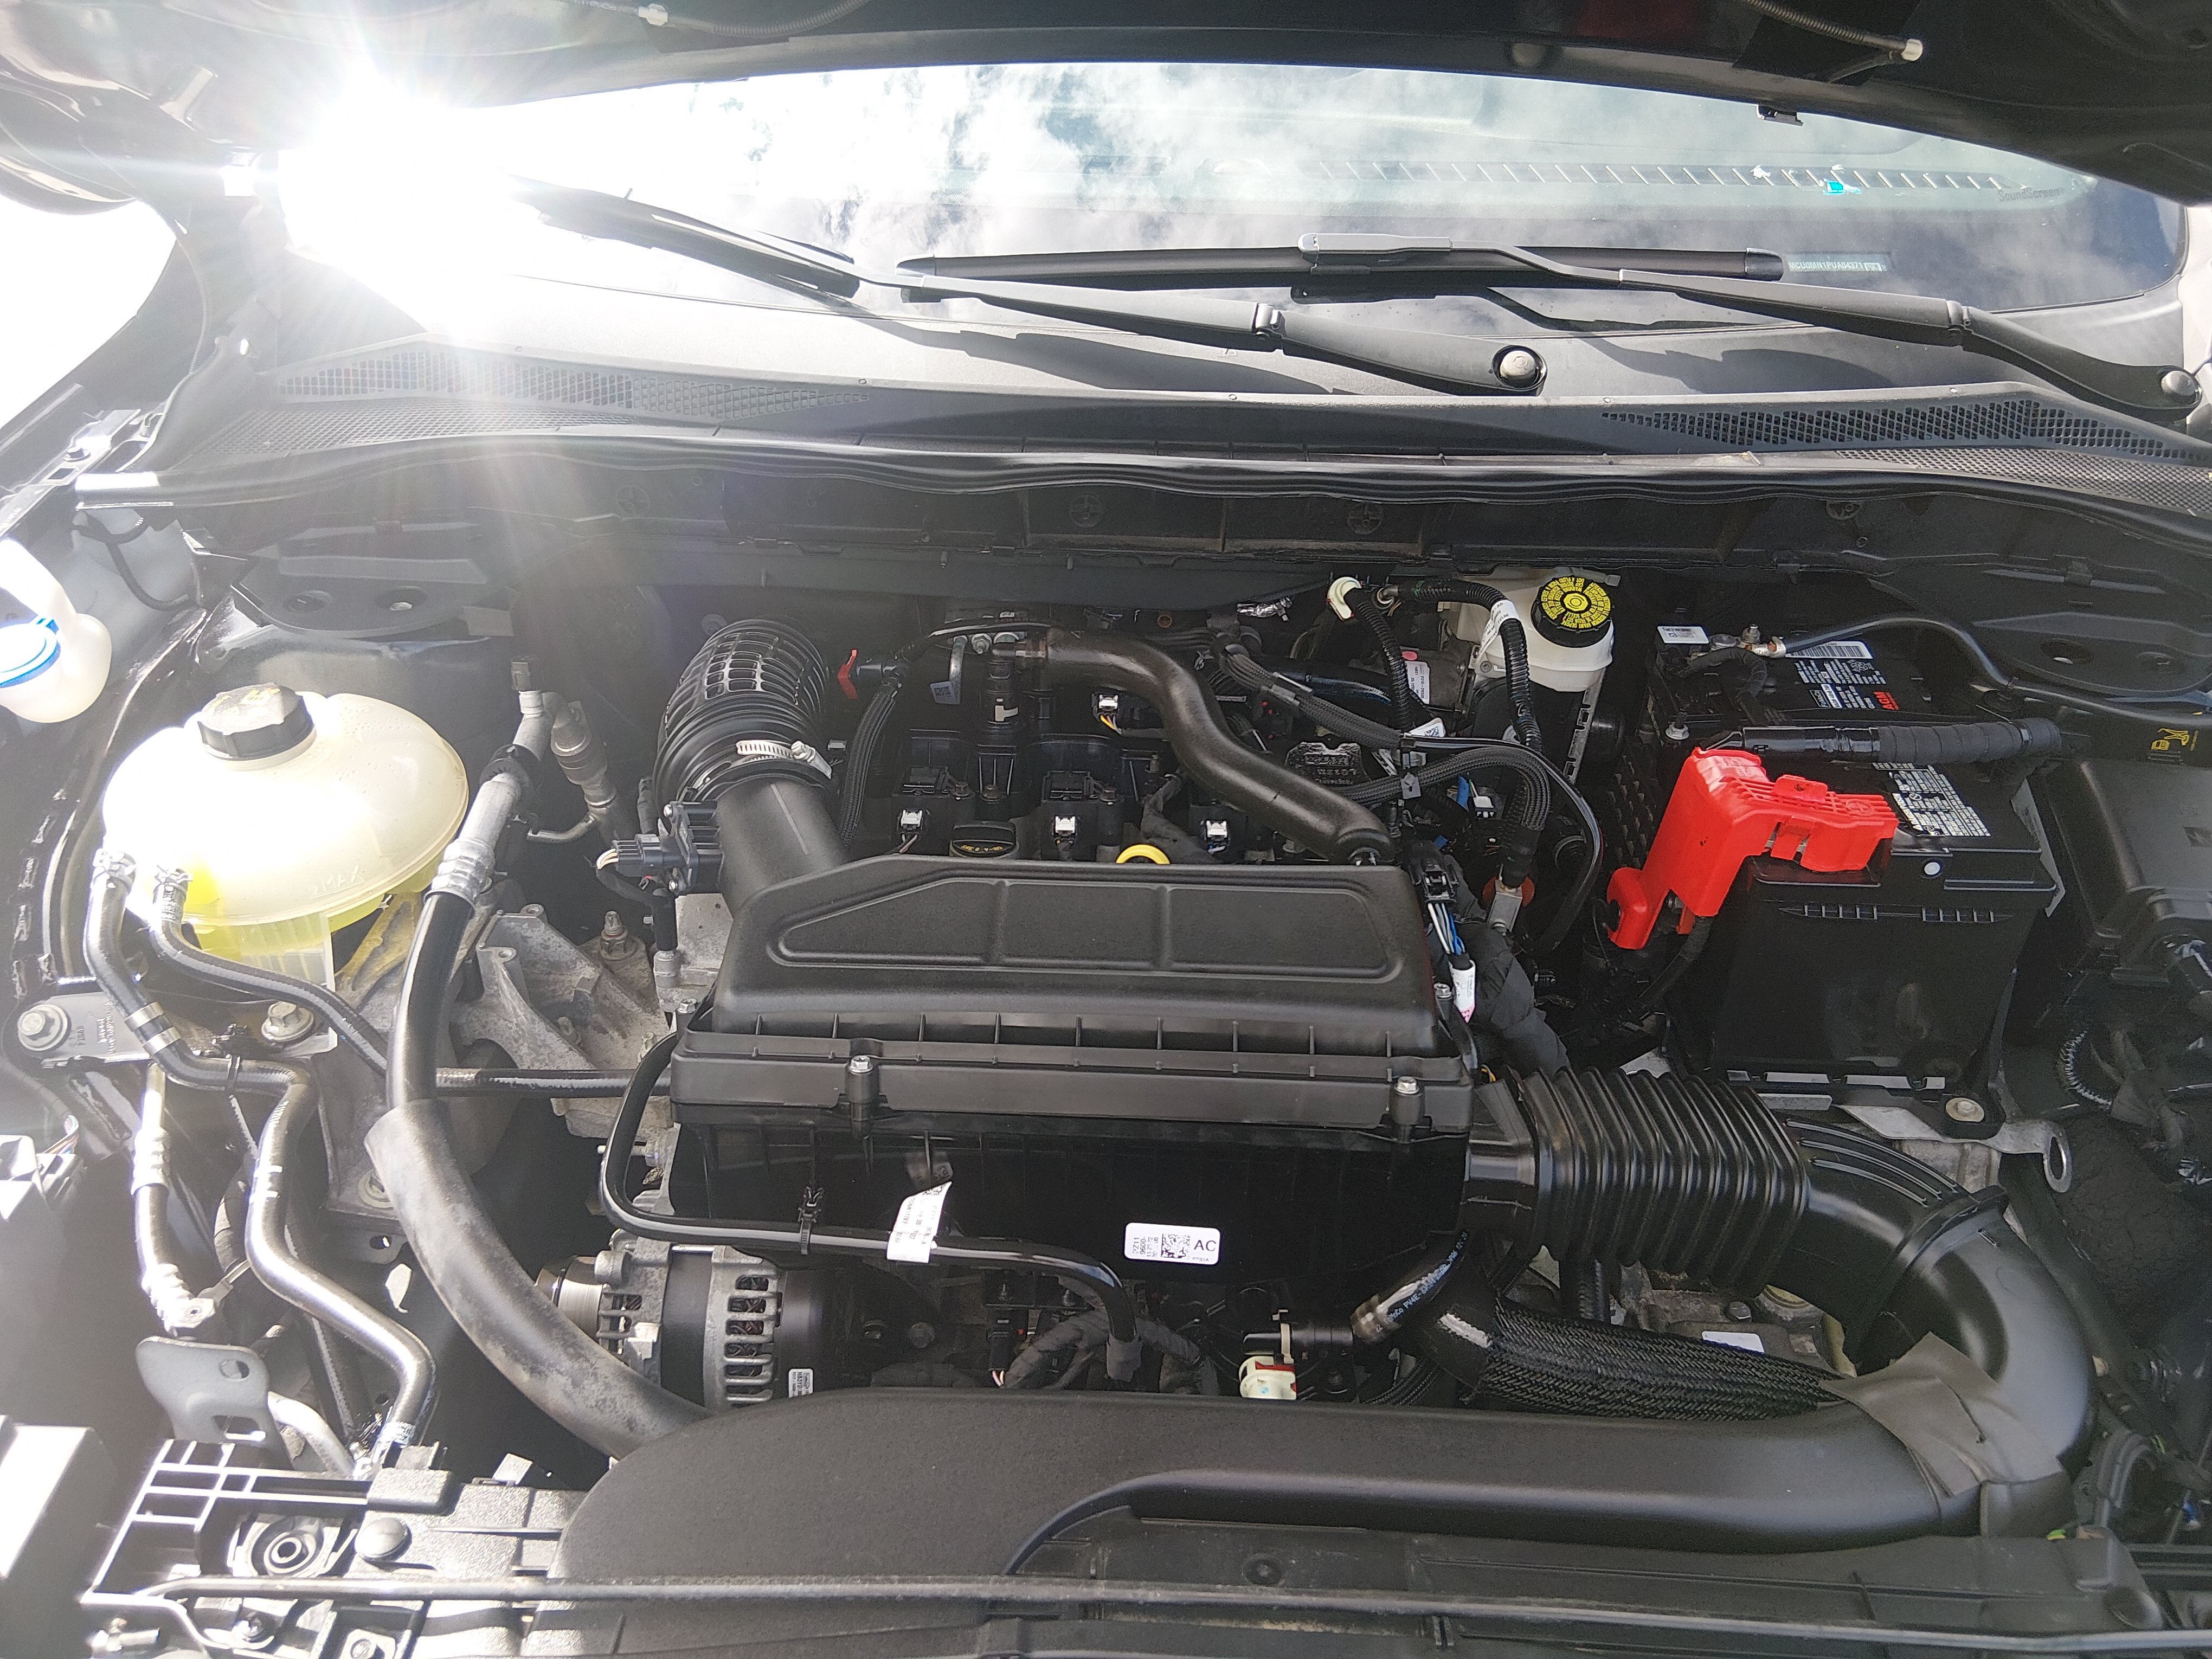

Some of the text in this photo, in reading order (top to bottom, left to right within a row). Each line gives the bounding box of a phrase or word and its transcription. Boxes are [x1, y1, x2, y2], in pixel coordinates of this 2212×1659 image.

[1997, 187, 2060, 202] SoundScreen
[1874, 691, 1895, 710] AGM
[1193, 1239, 1217, 1252] AC
